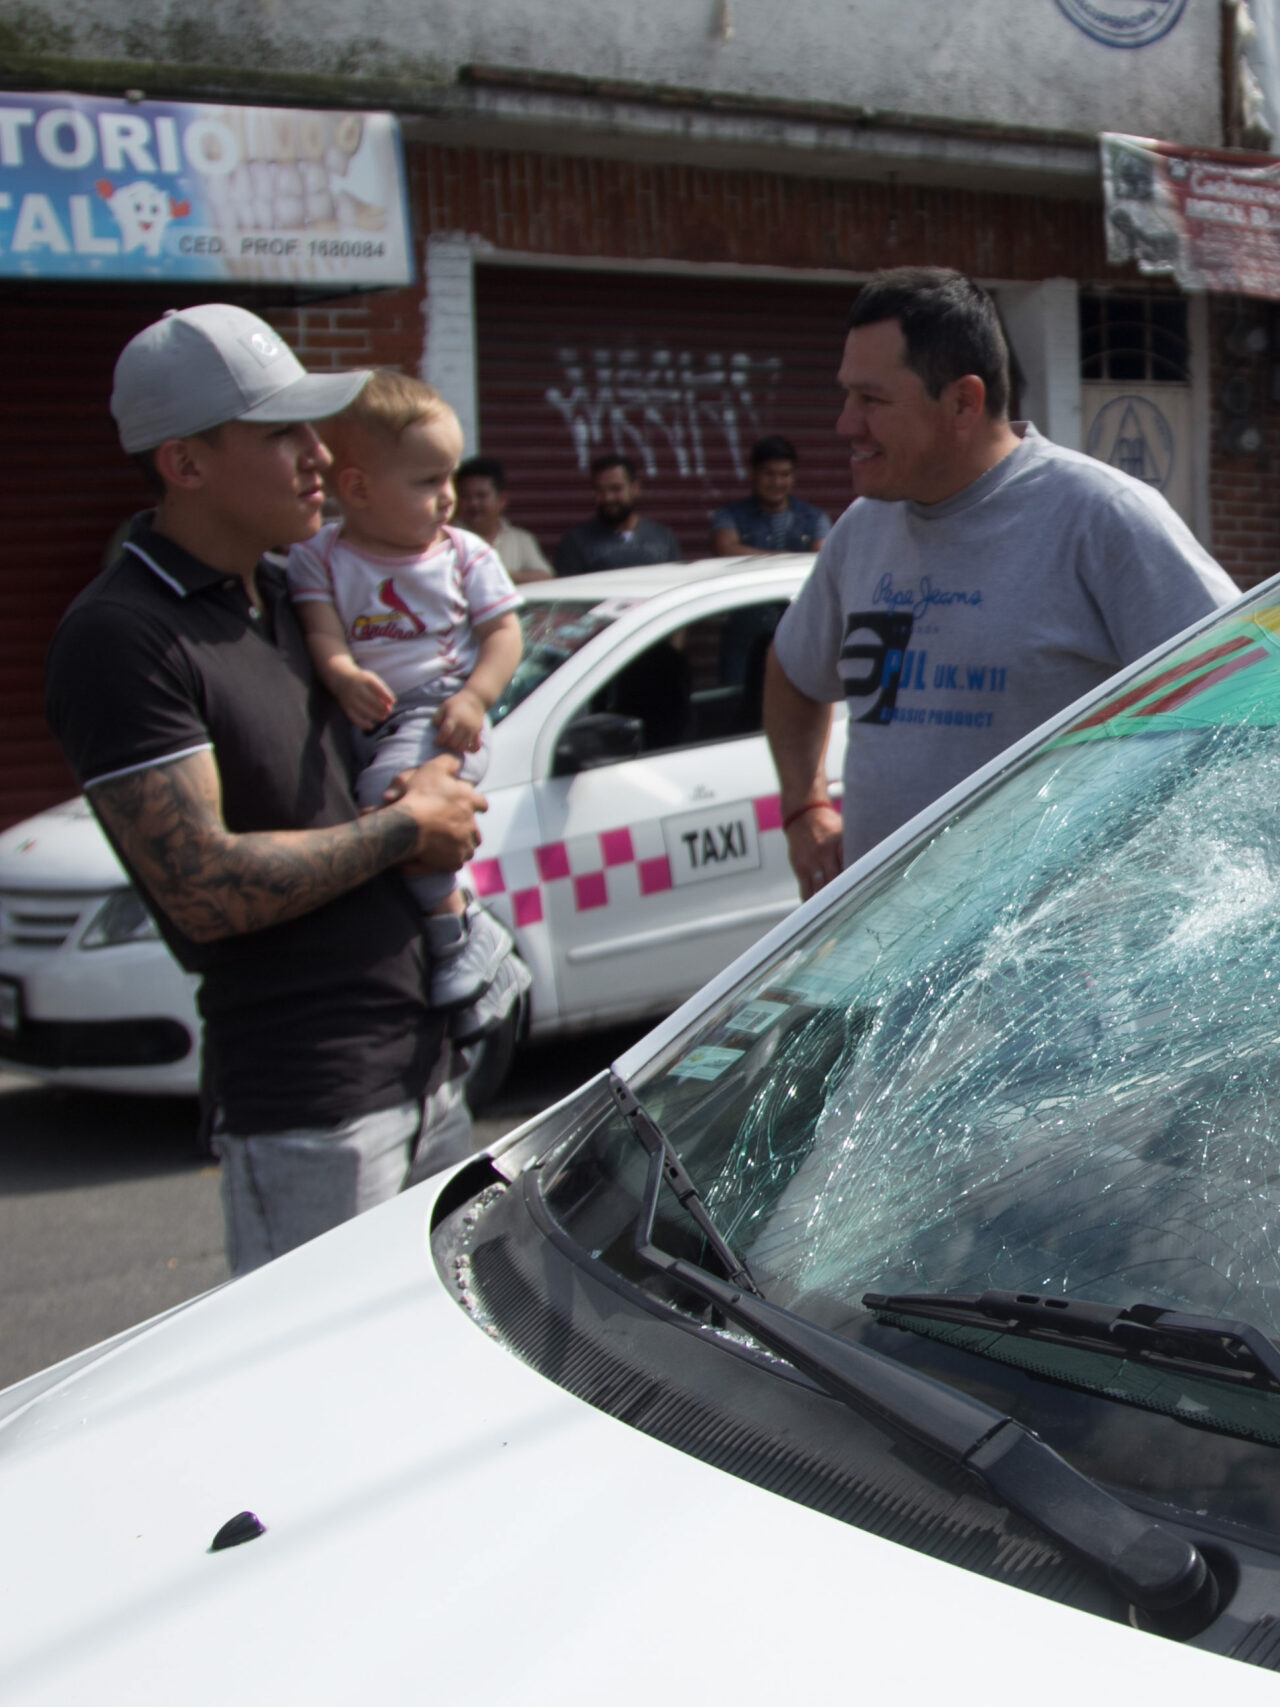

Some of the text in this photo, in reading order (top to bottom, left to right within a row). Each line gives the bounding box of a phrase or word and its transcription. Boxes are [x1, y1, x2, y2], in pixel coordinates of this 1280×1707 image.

[0, 193, 118, 255] AL
[912, 575, 984, 620] Jeans
[681, 819, 748, 869] TAXI
